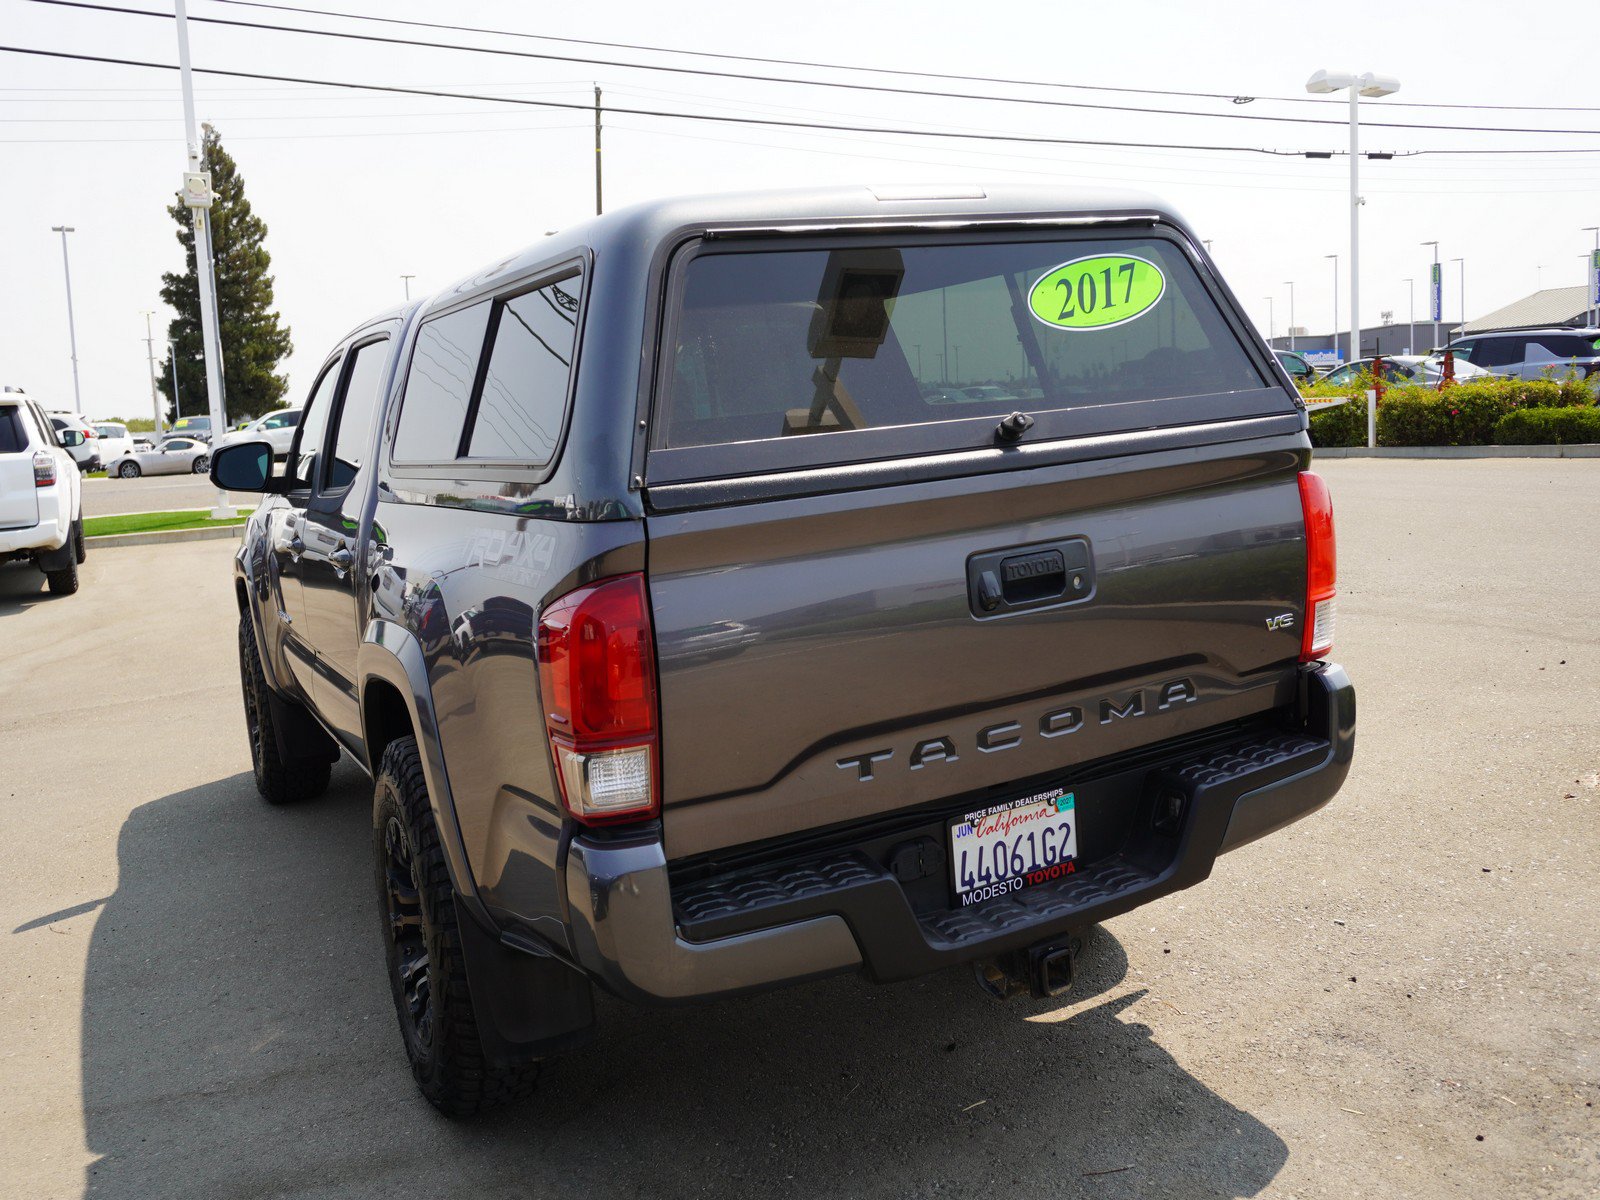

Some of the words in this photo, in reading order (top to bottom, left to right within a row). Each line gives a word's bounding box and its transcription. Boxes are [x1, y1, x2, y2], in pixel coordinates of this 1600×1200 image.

[1055, 262, 1136, 321] 2017
[1008, 557, 1062, 579] TOYOTA
[1265, 612, 1294, 632] V6
[835, 677, 1198, 782] TACOMA
[964, 809, 987, 822] PRICE
[988, 802, 1014, 816] FAMILY
[1015, 788, 1064, 808] DEALERSHIPS
[976, 806, 1056, 838] California
[956, 823, 973, 839] JUN
[960, 822, 1073, 889] 44061G2
[962, 877, 1023, 907] MODESTO
[1026, 861, 1076, 886] TOYOTA
